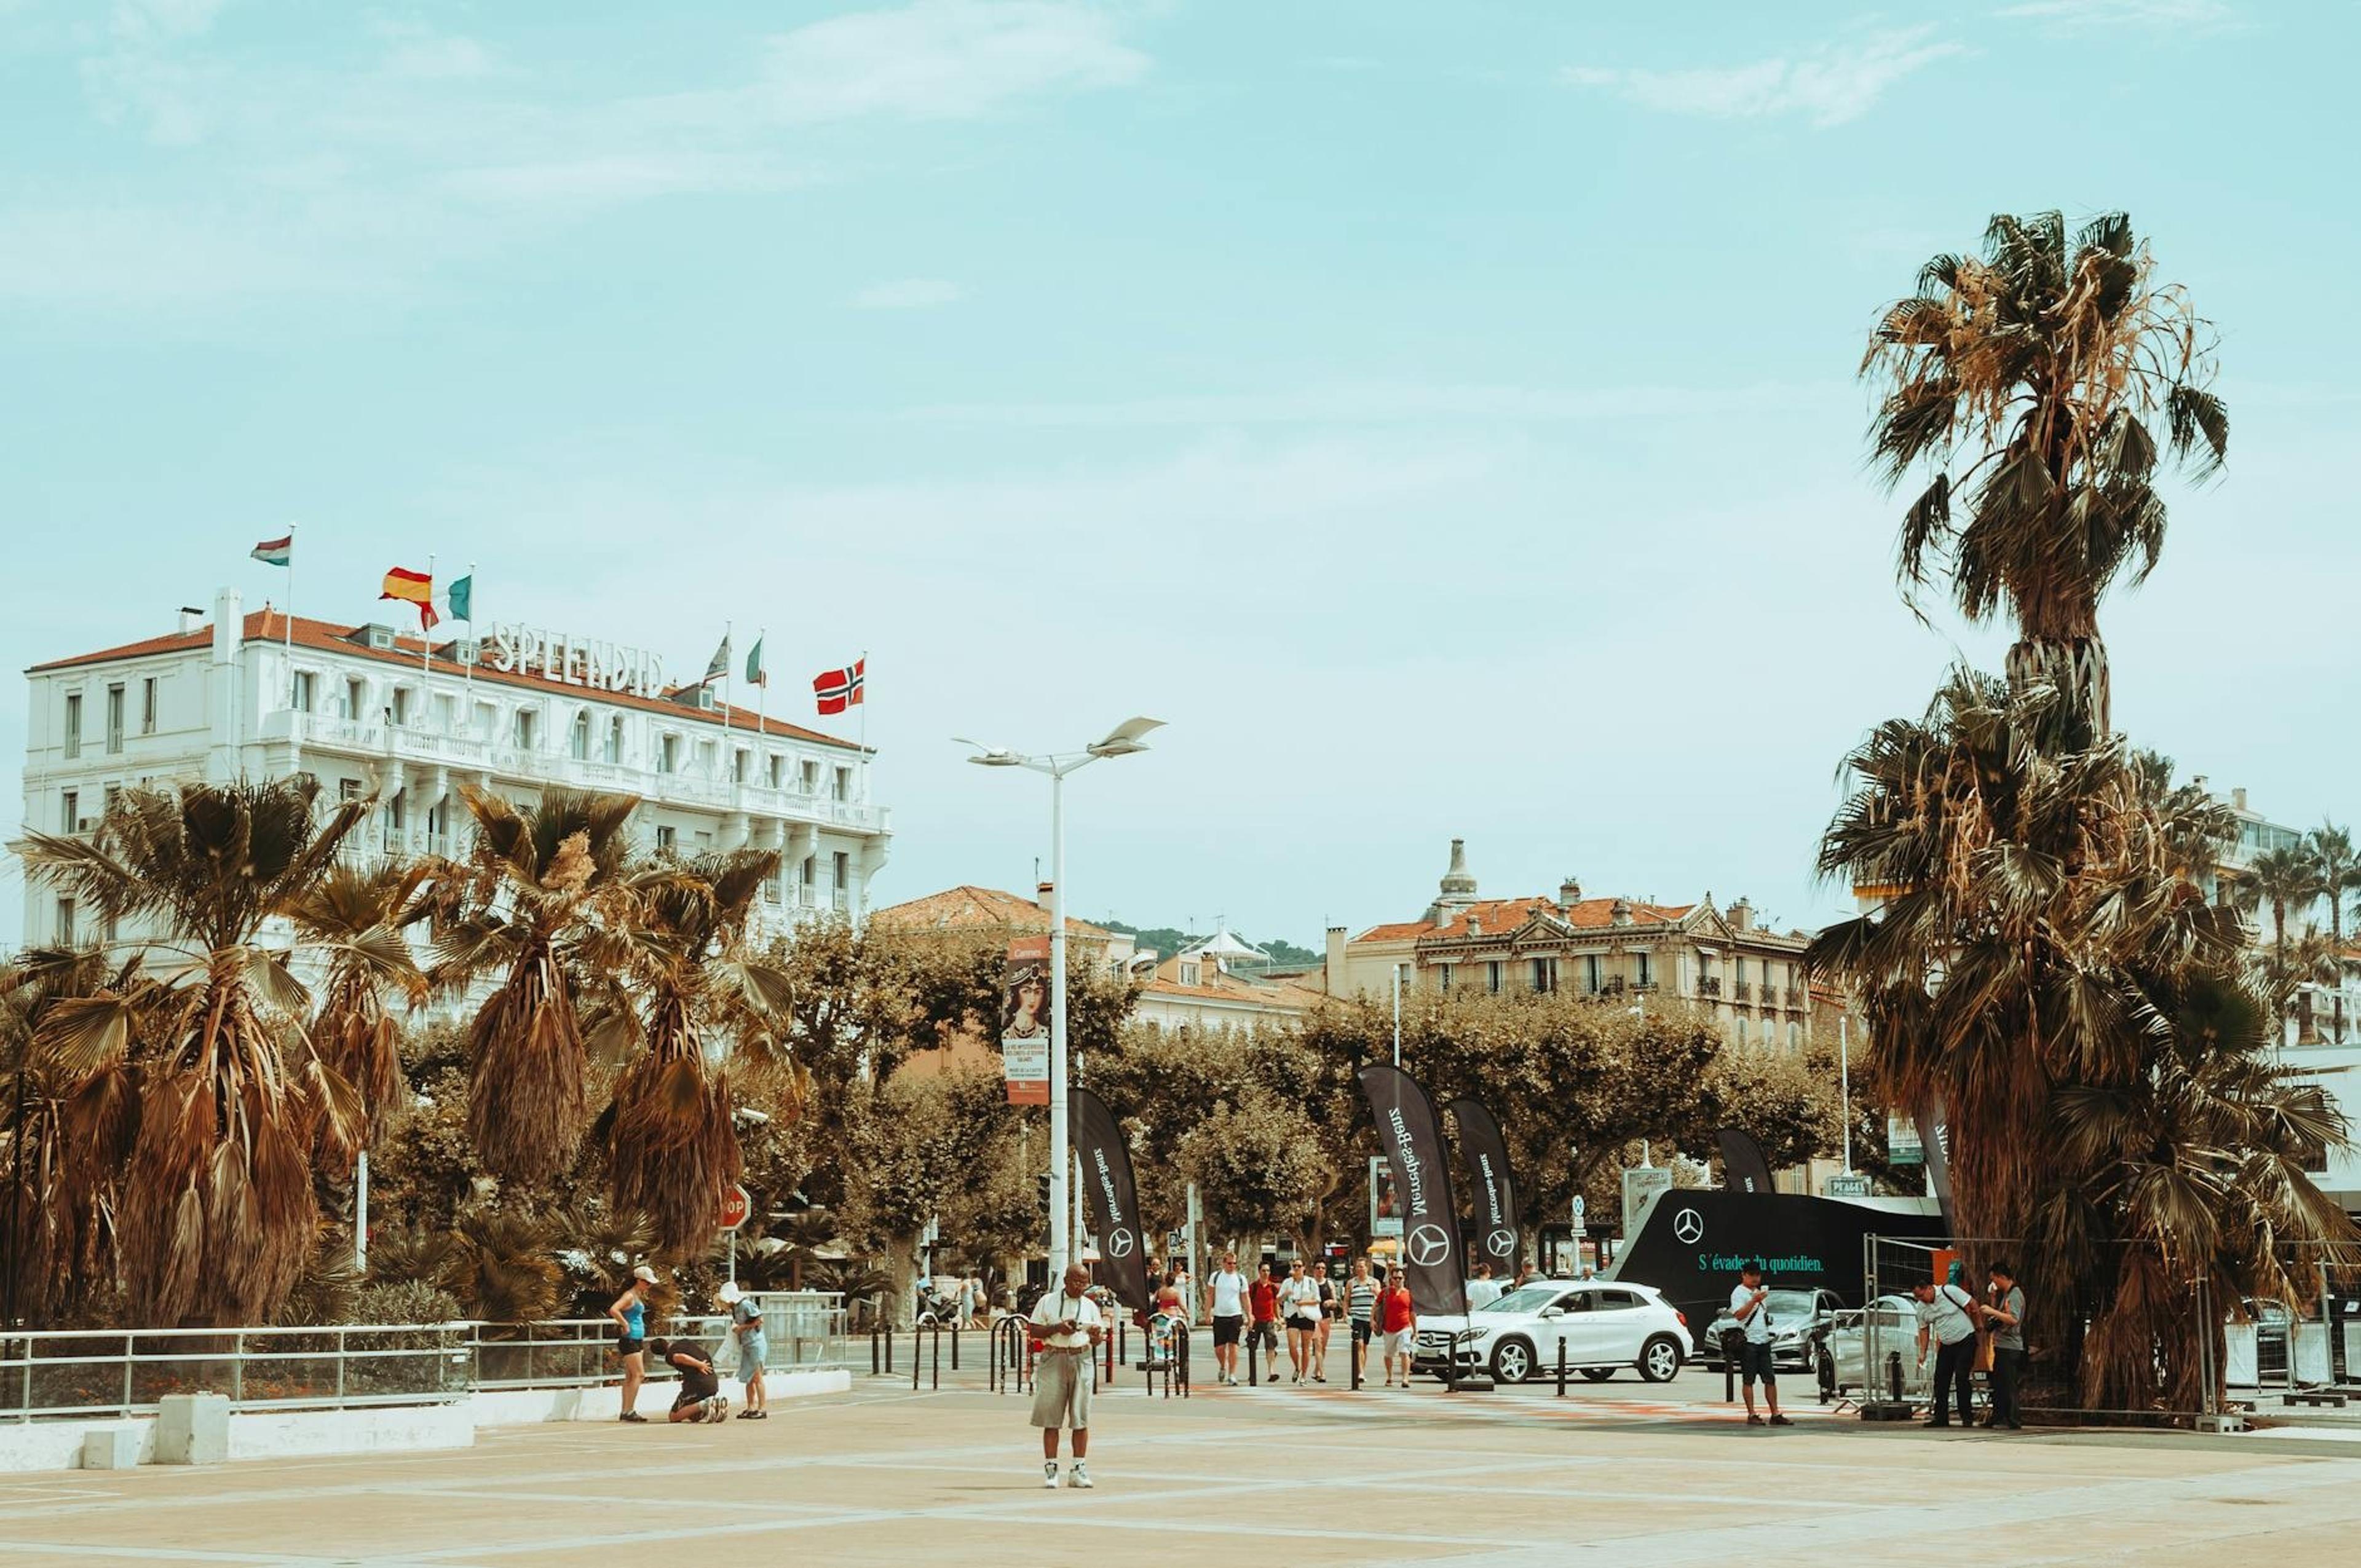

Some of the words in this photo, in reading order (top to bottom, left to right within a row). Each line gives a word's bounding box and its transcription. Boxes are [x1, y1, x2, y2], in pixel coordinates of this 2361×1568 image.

[492, 623, 663, 699] SPLENDID
[728, 1201, 744, 1213] OP
[1770, 1255, 1824, 1274] quotidien.
